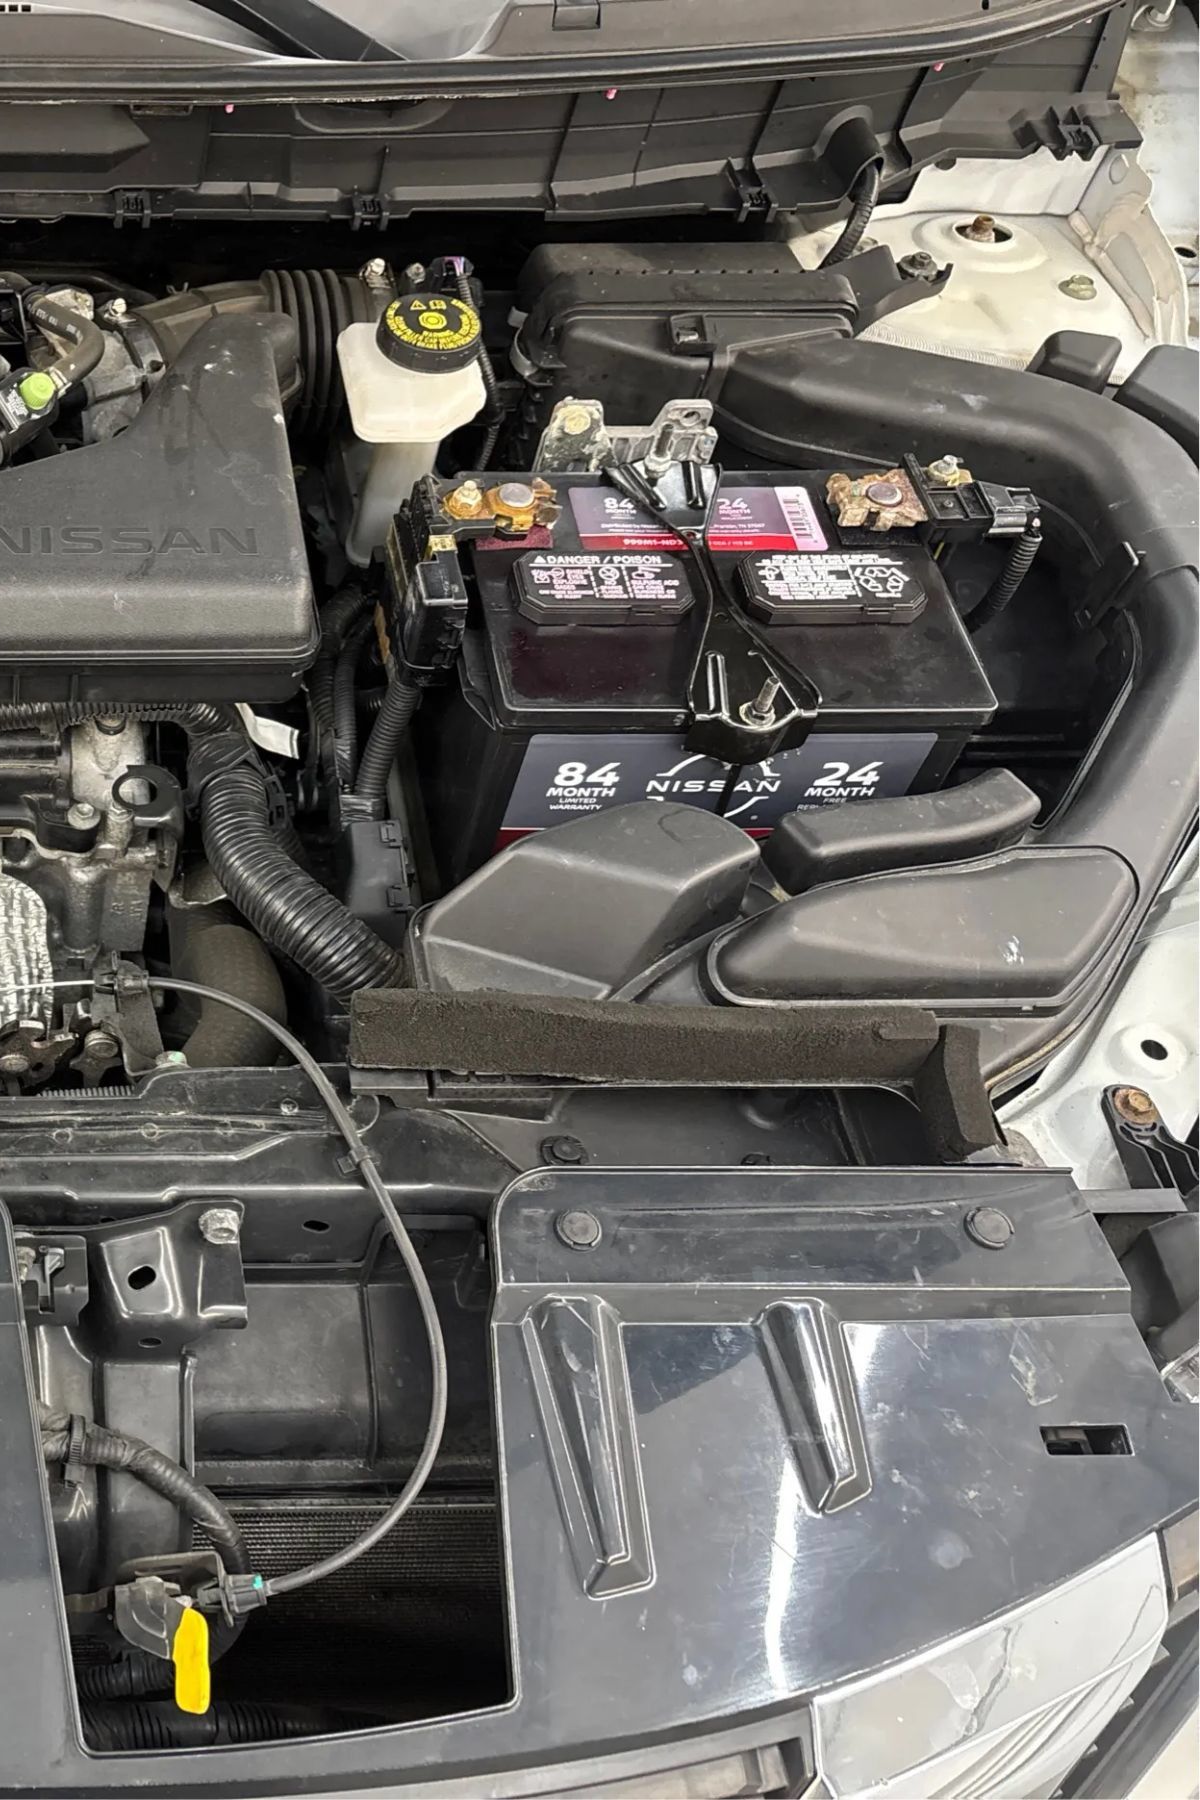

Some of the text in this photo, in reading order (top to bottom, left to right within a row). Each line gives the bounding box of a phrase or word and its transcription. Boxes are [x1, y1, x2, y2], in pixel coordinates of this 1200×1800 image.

[603, 497, 634, 509] 84
[716, 498, 748, 509] 24
[547, 556, 600, 564] DANGER
[613, 555, 661, 564] POISON
[553, 762, 621, 787] 84
[813, 762, 884, 787] 24
[646, 780, 781, 792] NISSAN
[545, 787, 616, 797] MONTH
[804, 787, 875, 797] MONTH
